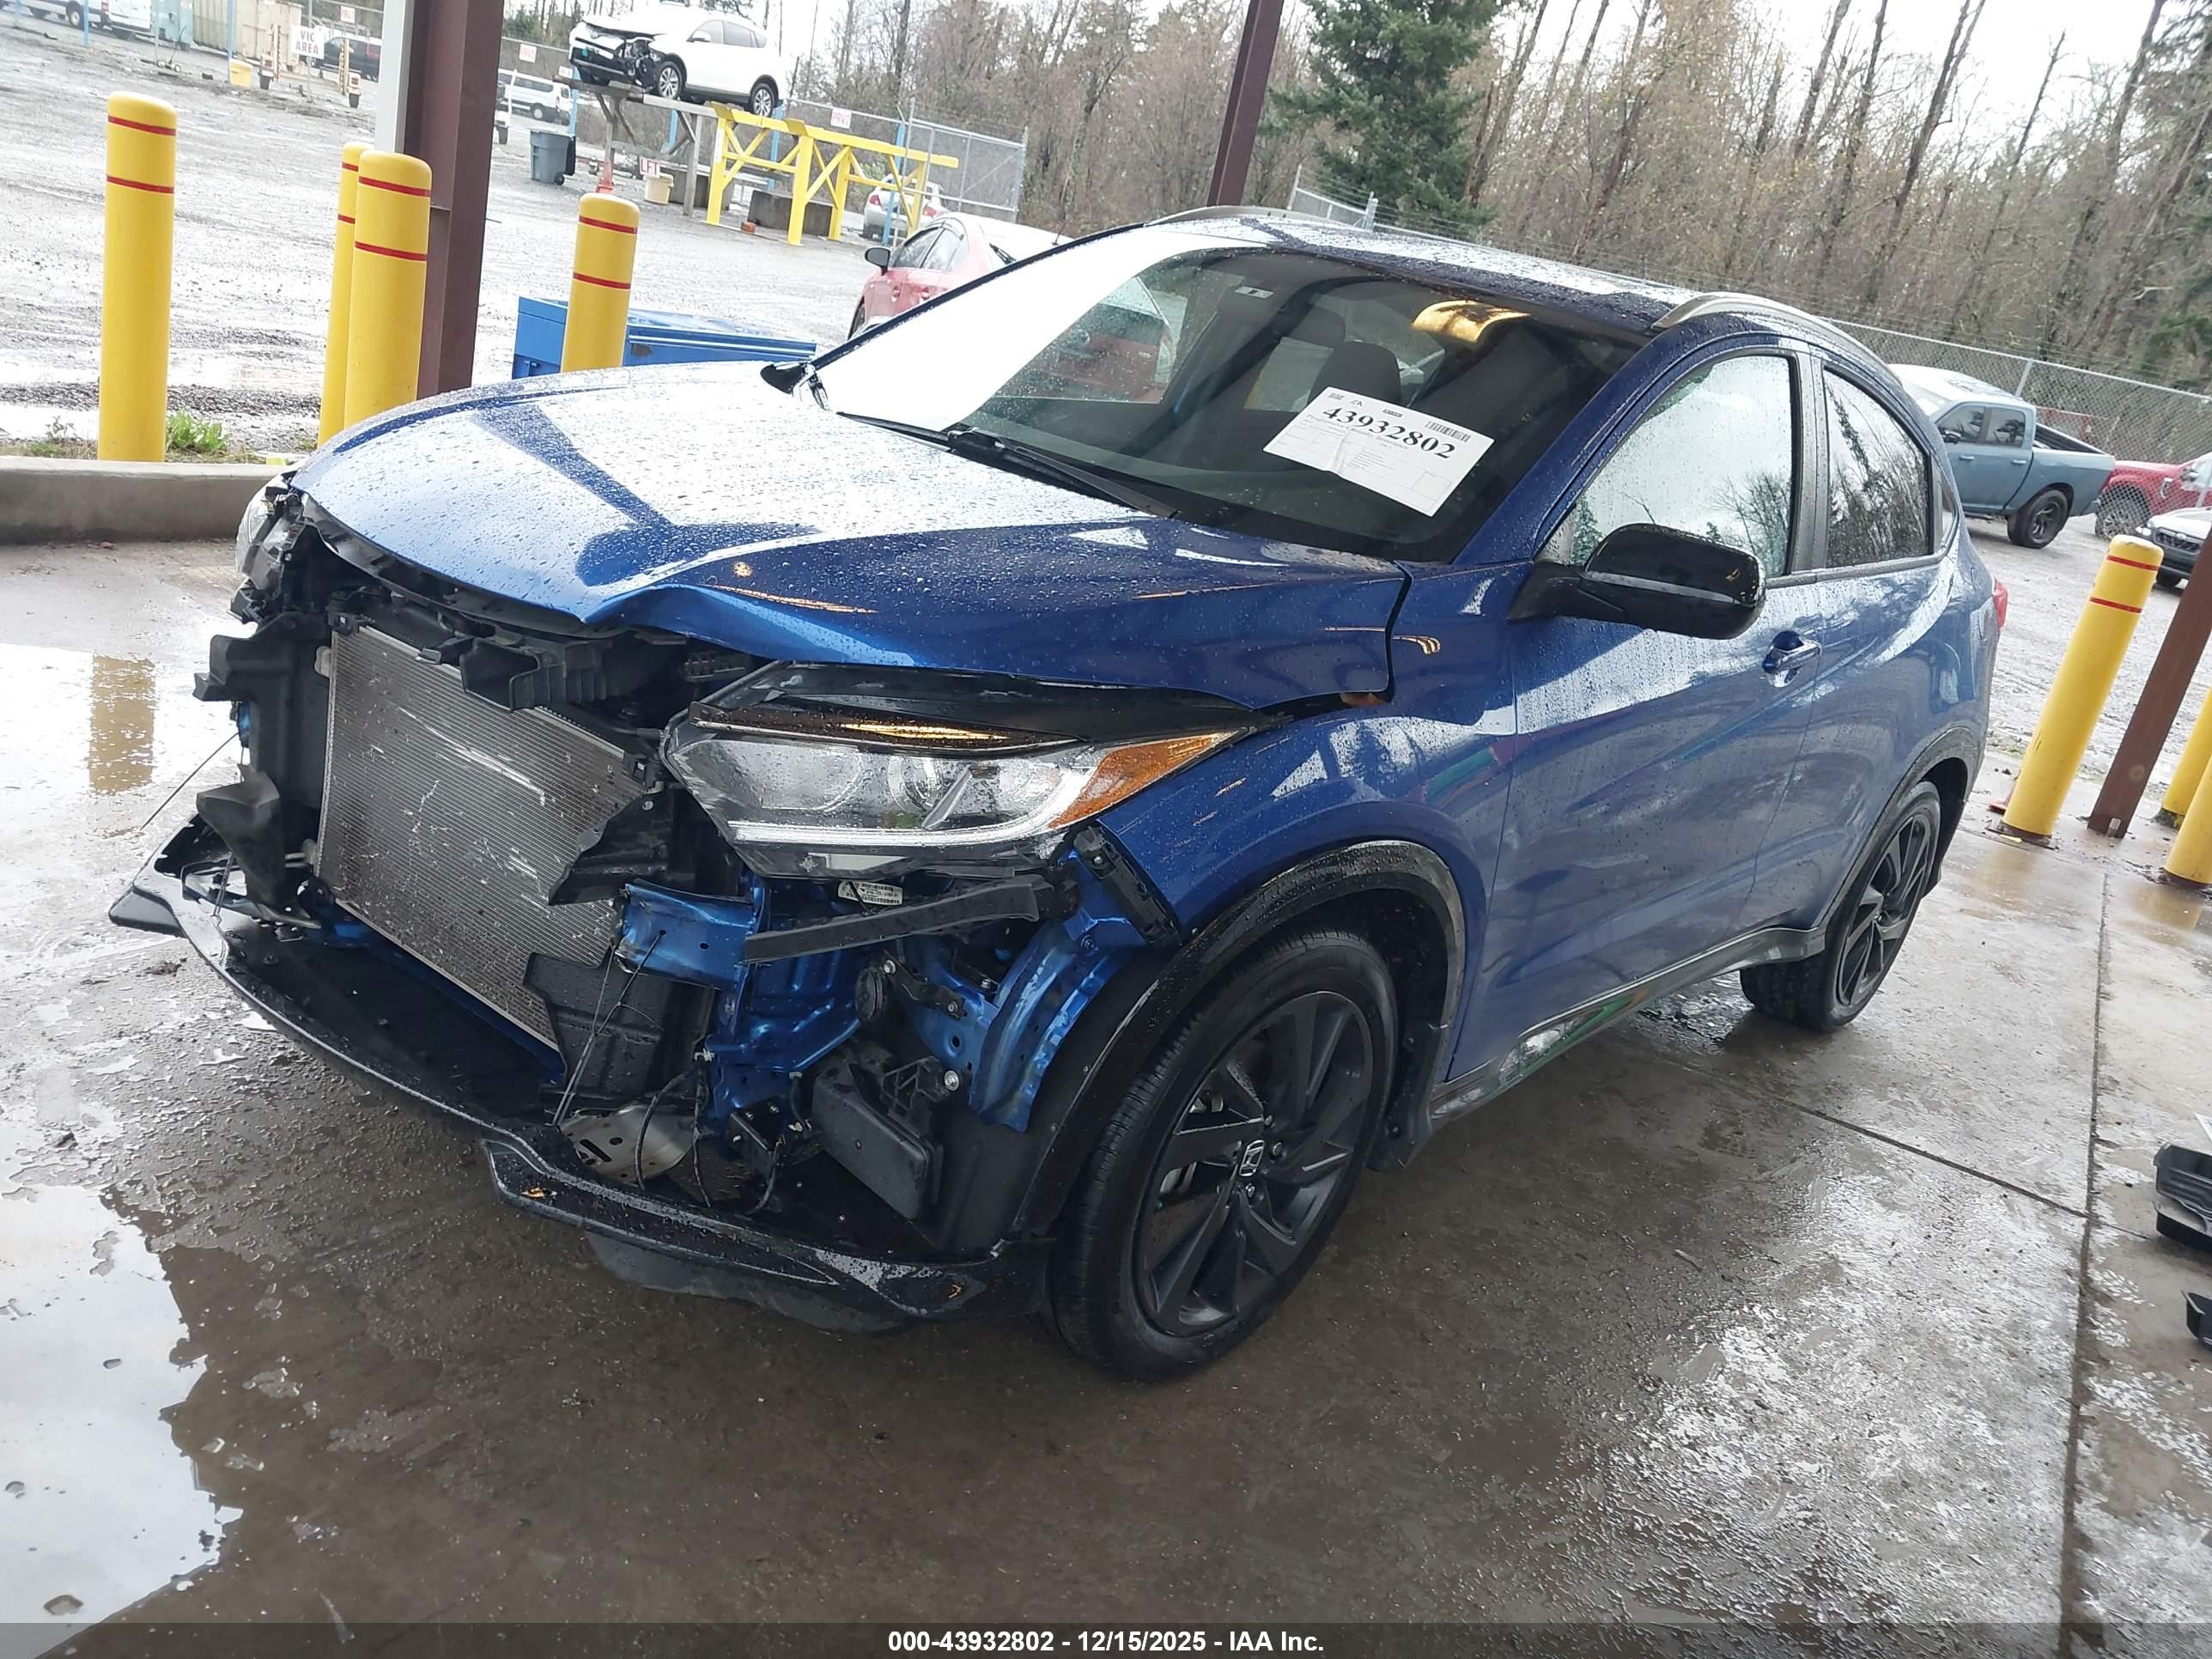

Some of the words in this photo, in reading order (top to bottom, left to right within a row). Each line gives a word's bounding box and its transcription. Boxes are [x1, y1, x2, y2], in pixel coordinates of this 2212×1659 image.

[301, 29, 315, 43] VIC
[295, 40, 319, 56] AREA
[1323, 407, 1455, 459] 43932802
